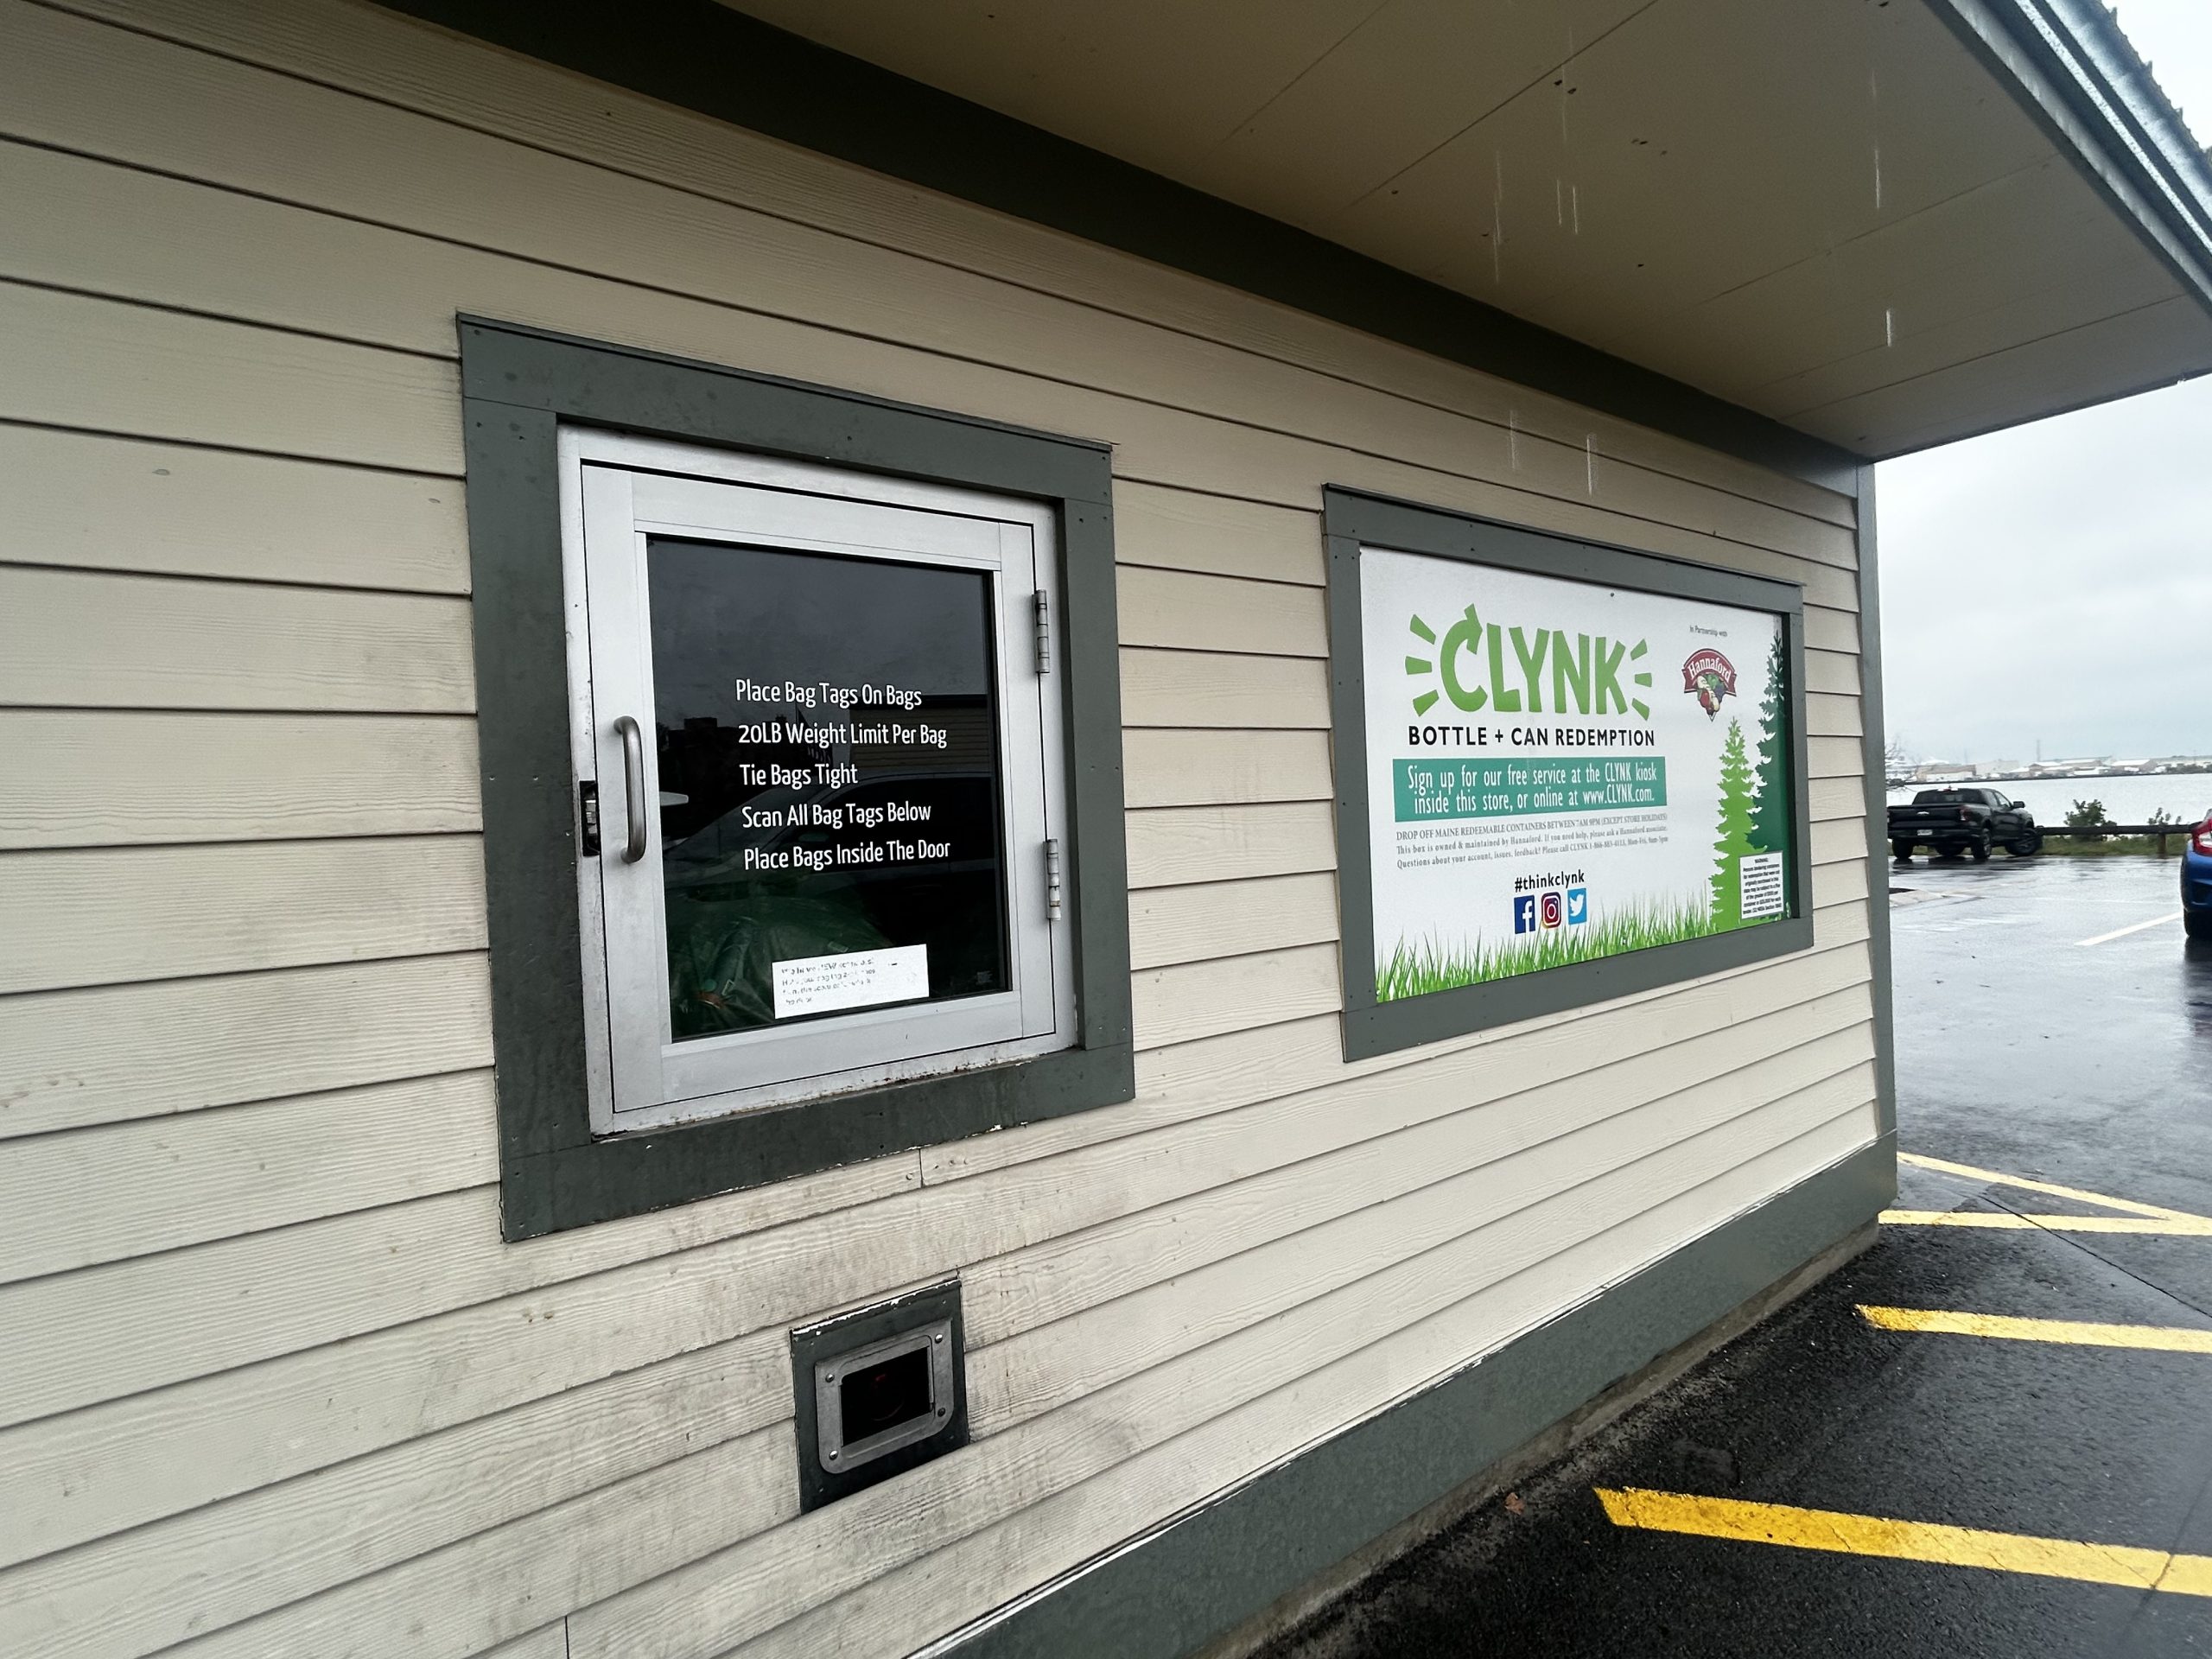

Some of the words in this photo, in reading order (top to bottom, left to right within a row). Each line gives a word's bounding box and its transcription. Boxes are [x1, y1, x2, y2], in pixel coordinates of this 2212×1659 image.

[1440, 603, 1628, 715] CLYNK
[1688, 657, 1732, 683] Hannaford
[736, 678, 780, 702] Place
[785, 681, 816, 708] Bag
[818, 682, 858, 709] Tags
[861, 683, 882, 704] On
[886, 684, 922, 710] Bags
[738, 721, 782, 743] 20LB
[785, 722, 847, 749] Weight
[850, 723, 889, 744] Limit
[892, 723, 917, 744] Per
[919, 724, 947, 749] Bag
[1408, 725, 1487, 746] BOTTLE
[1510, 727, 1548, 746] CAN
[1555, 728, 1655, 747] REDEMPTION
[739, 764, 766, 785] Tie
[771, 764, 811, 790] Bags
[815, 763, 858, 789] Tight
[1408, 765, 1433, 796] Sign
[1440, 771, 1455, 795] up
[1461, 764, 1478, 787] for
[1484, 770, 1502, 787] our
[1508, 764, 1528, 785] free
[1533, 763, 1566, 785] service
[1571, 767, 1581, 784] at
[1586, 762, 1599, 783] the
[1605, 762, 1631, 783] CLYNK
[1636, 761, 1657, 781] kiosk
[1414, 789, 1449, 814] inside
[1456, 789, 1477, 812] this
[1483, 792, 1513, 812] store,
[1517, 792, 1528, 809] or
[1534, 786, 1563, 808] online
[1568, 789, 1578, 806] at
[1583, 784, 1655, 805] www.CLYNK.com.
[741, 805, 782, 828] Scan
[786, 804, 808, 826] All
[812, 804, 843, 830] Bag
[845, 803, 883, 828] Tags
[887, 800, 931, 822] Below
[1396, 830, 1418, 841] DROP
[1420, 830, 1433, 839] OFF
[1435, 827, 1459, 838] MAINE
[1460, 823, 1505, 836] REDEEMABLE
[1506, 821, 1547, 832] CONTAINERS
[1548, 819, 1575, 830] BETWEEN
[744, 847, 789, 870] Place
[793, 846, 833, 871] Bags
[836, 841, 883, 864] Inside
[886, 839, 915, 861] The
[918, 839, 950, 859] Door
[1396, 846, 1411, 855] This
[1413, 844, 1425, 853] box
[1427, 843, 1433, 852] is
[1435, 842, 1456, 851] owned
[1465, 837, 1500, 849] maintained
[1501, 838, 1509, 847] by
[1397, 857, 1430, 869] Questions
[1432, 855, 1451, 865] about
[1452, 855, 1466, 864] your
[1467, 850, 1493, 862] account,
[1515, 868, 1585, 893] #thinkclynk
